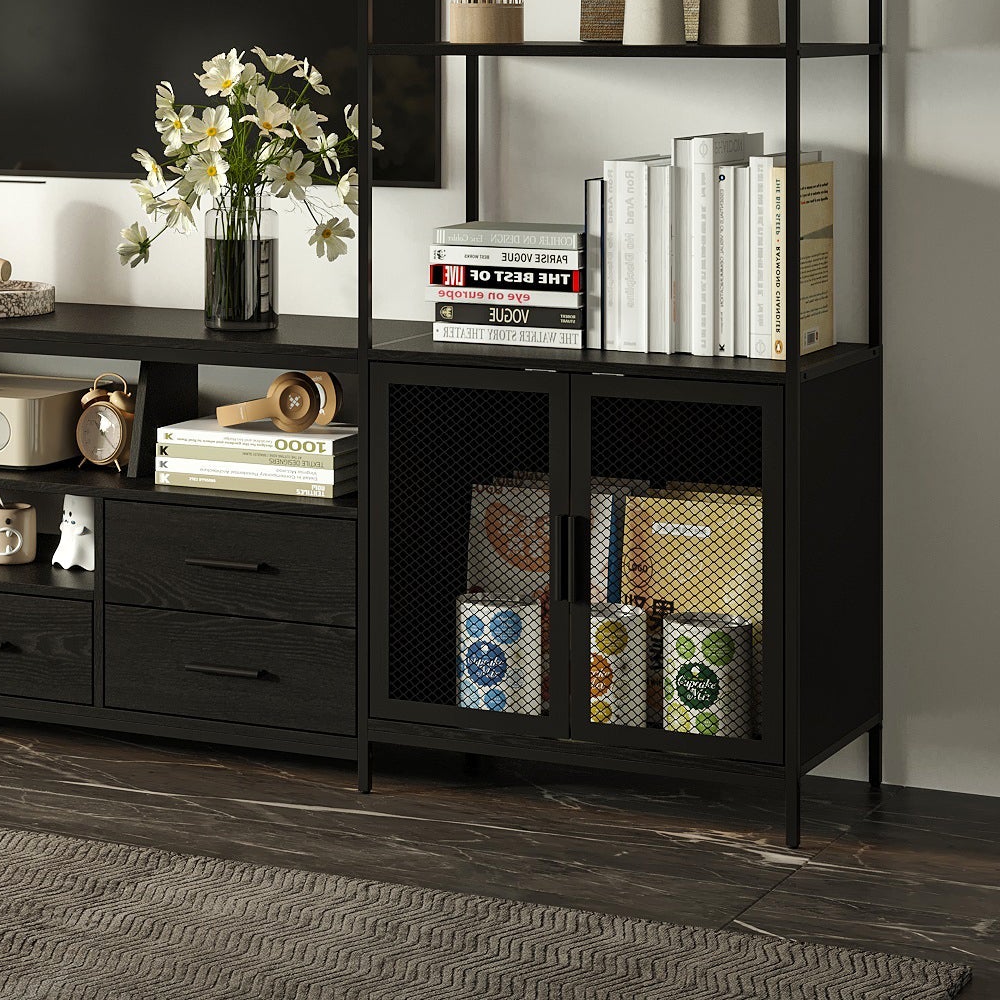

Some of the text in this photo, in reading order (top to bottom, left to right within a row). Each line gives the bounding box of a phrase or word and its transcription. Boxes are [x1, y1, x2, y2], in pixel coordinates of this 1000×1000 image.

[160, 446, 169, 456] K
[274, 439, 326, 453] 1000
[302, 460, 324, 468] TEXTILE
[160, 473, 170, 484] K
